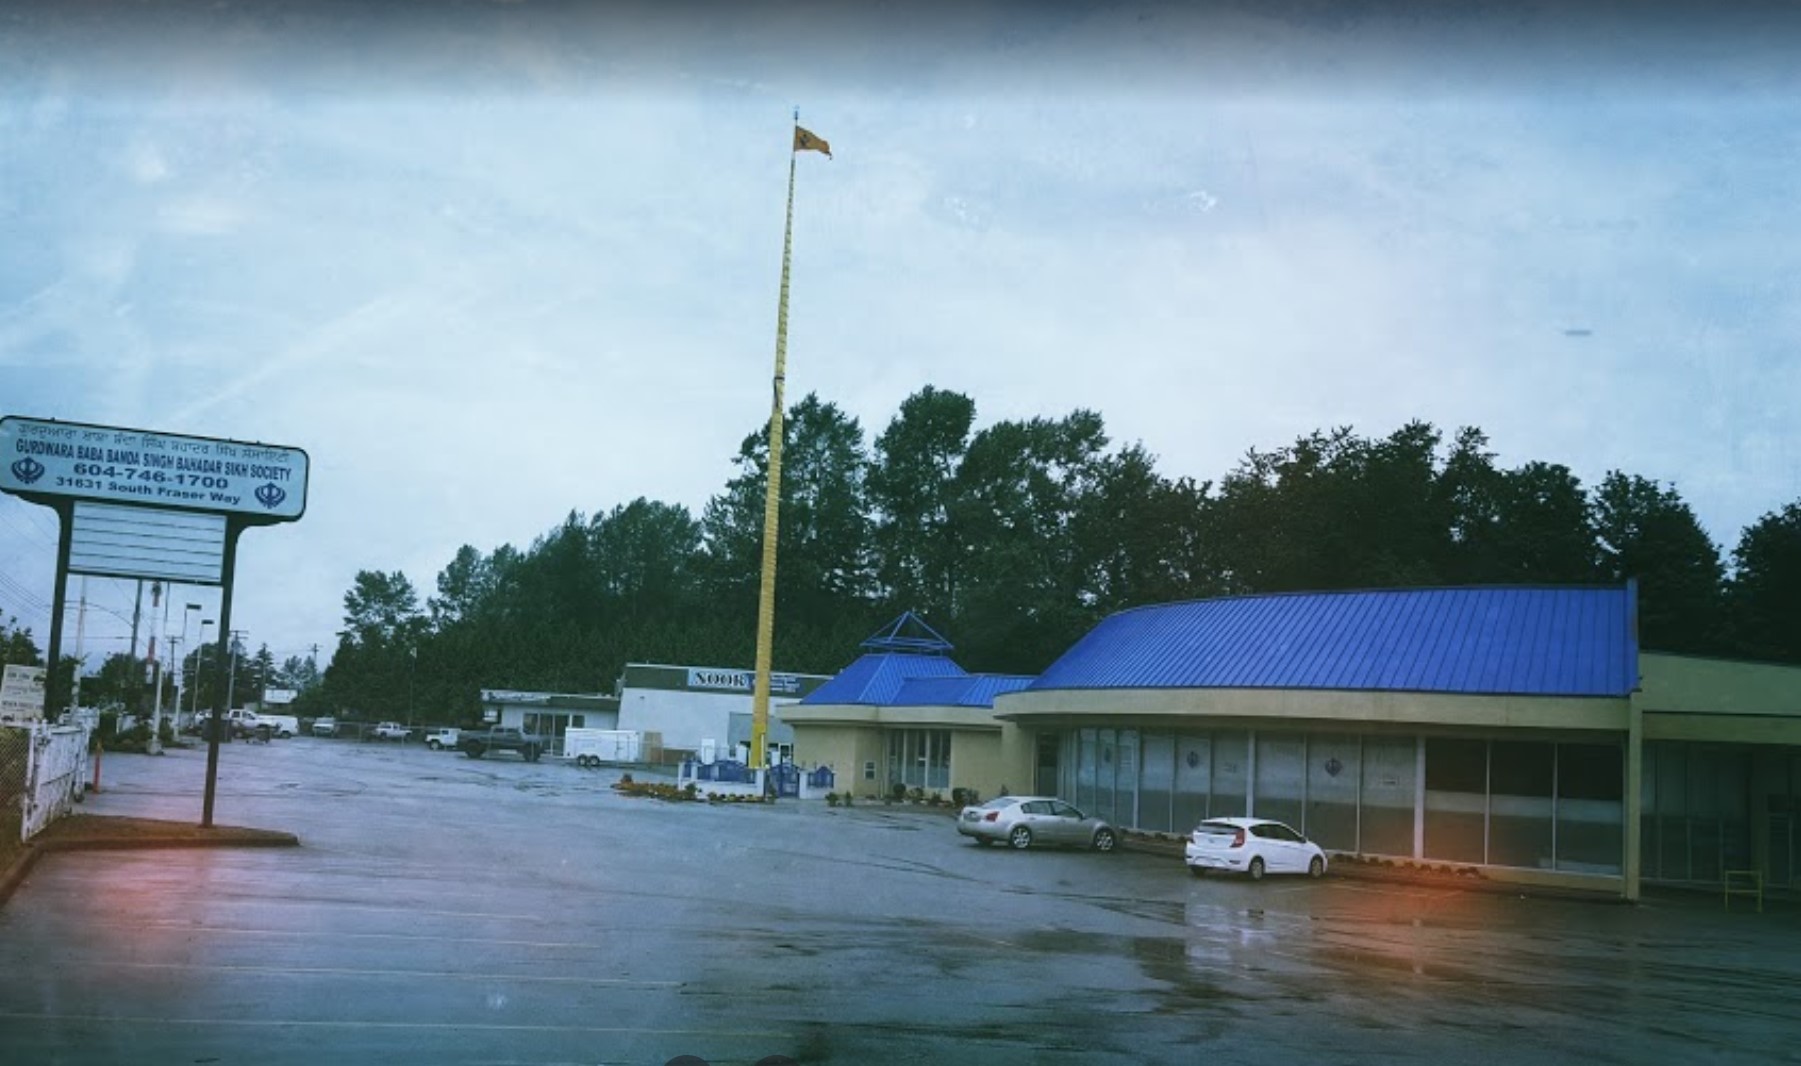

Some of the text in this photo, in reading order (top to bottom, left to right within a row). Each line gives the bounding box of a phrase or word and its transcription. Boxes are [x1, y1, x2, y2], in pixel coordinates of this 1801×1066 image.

[16, 438, 75, 460] GURDWARA
[77, 445, 104, 461] BABA
[106, 449, 140, 466] BANDA
[143, 453, 174, 470] SINGH
[225, 462, 249, 477] SIKH
[250, 464, 292, 482] SOCIETY
[56, 476, 241, 505] 31631 South Fraser Way
[73, 463, 229, 489] 604-746-1700
